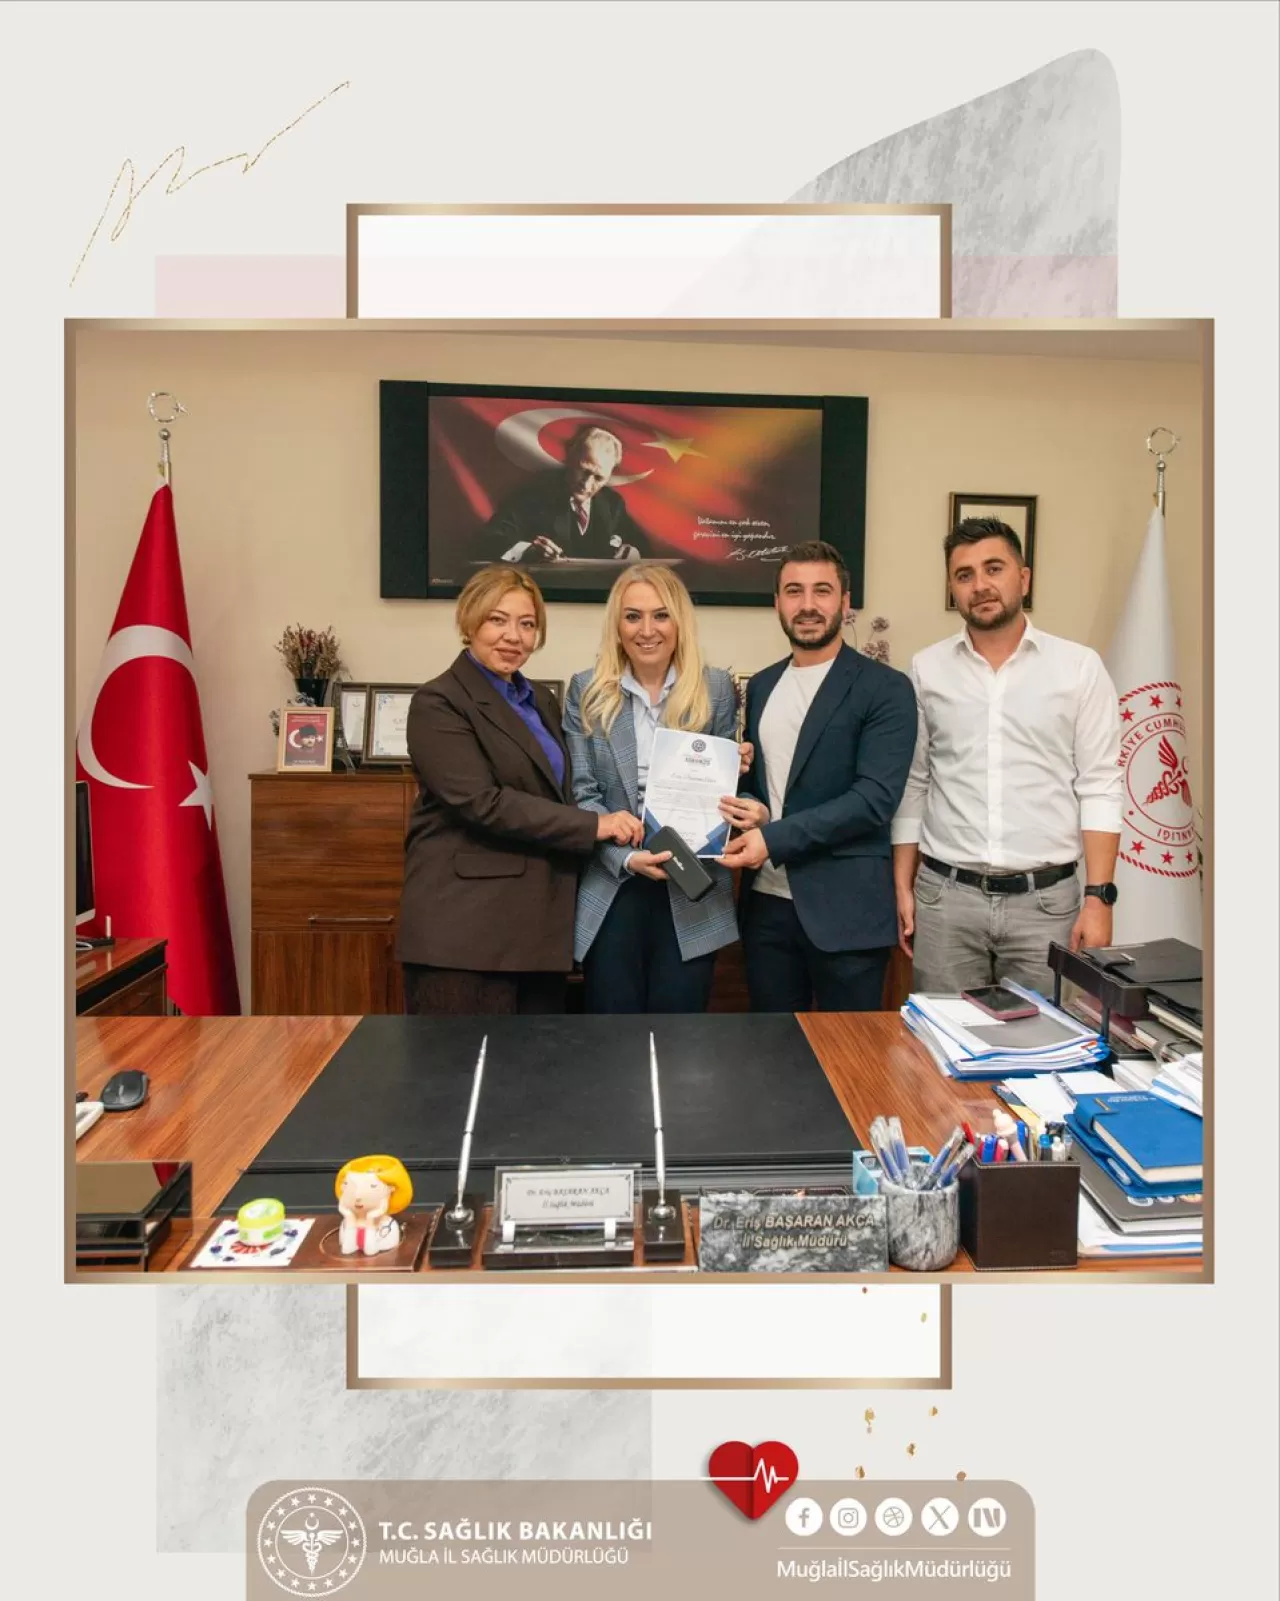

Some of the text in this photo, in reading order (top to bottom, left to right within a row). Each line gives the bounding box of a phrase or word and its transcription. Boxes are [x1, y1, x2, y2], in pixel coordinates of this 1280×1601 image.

[764, 1213, 833, 1231] BAŞARAN
[835, 1212, 876, 1229] AKÇA
[753, 1234, 797, 1251] Sağlık
